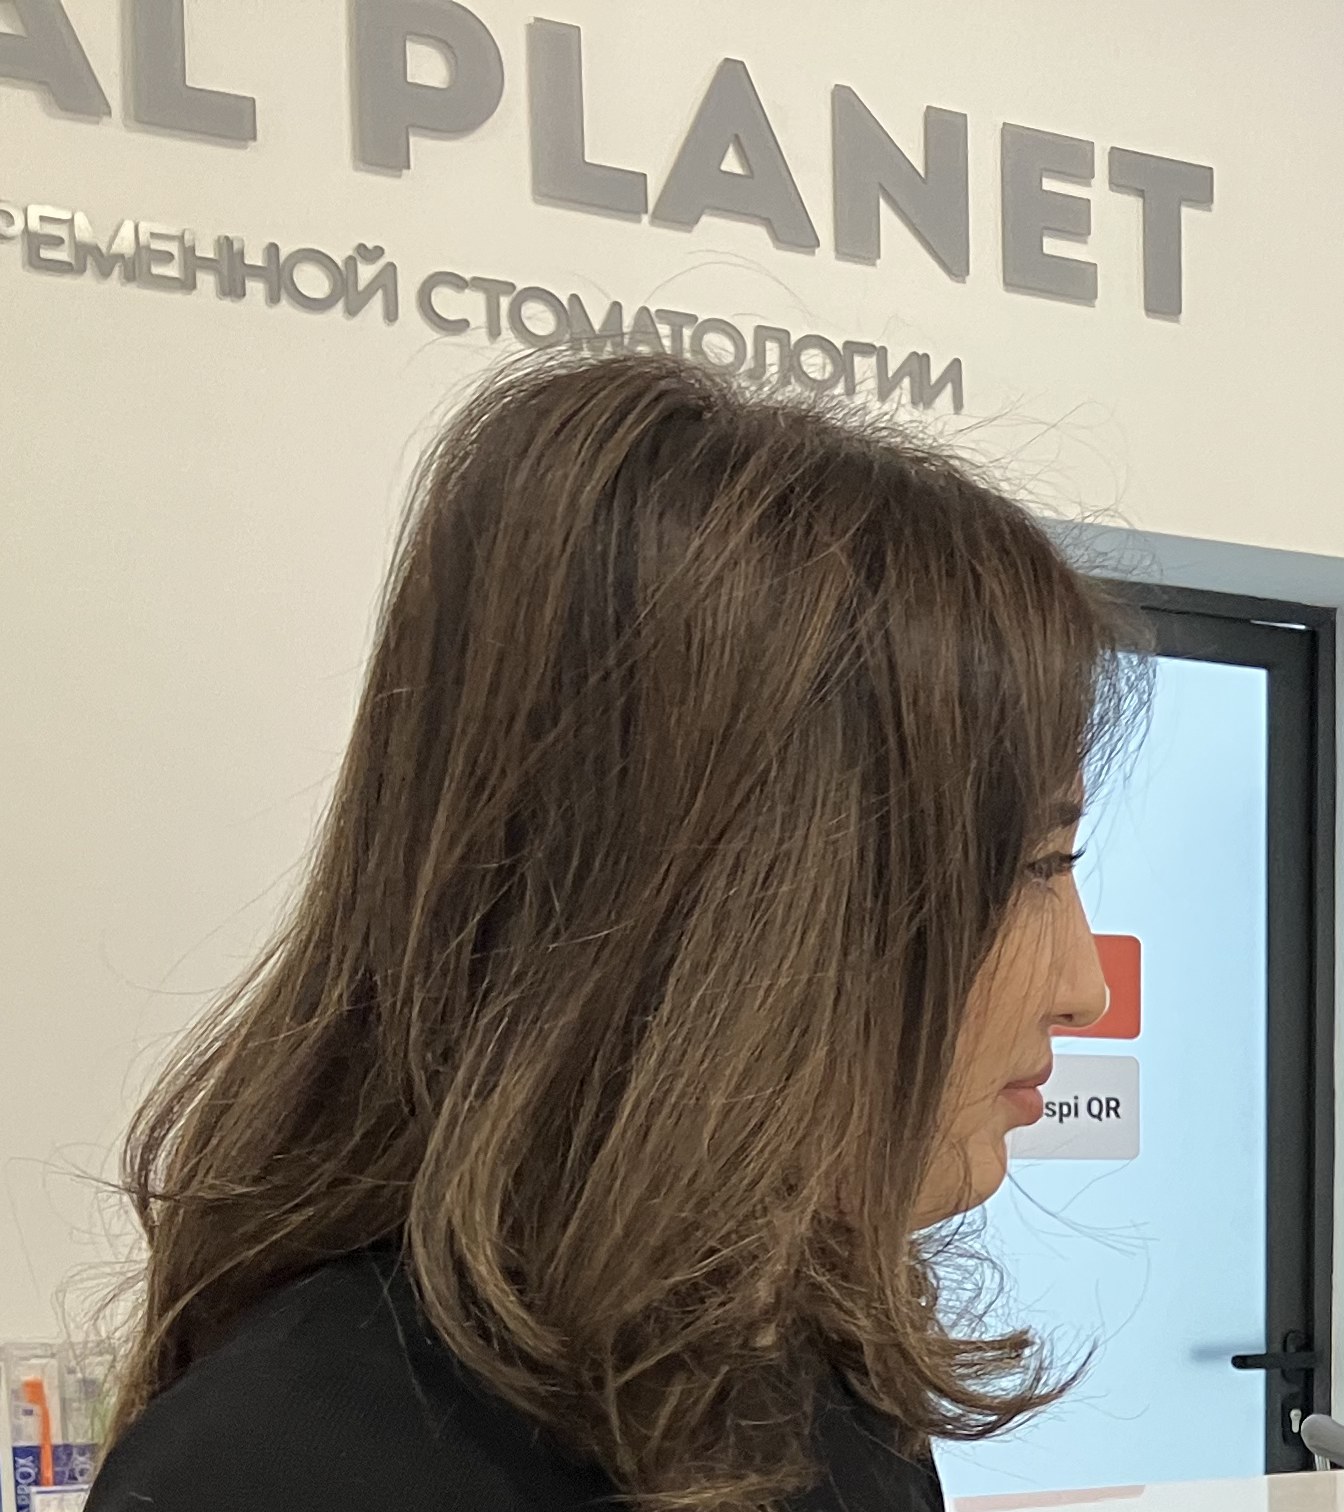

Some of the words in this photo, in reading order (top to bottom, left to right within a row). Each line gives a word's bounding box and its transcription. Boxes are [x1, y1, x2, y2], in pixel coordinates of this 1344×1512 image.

[351, 0, 1214, 319] PLANET
[416, 270, 963, 414] СТОМАТОЛОГИИ
[1086, 1096, 1121, 1122] QR
